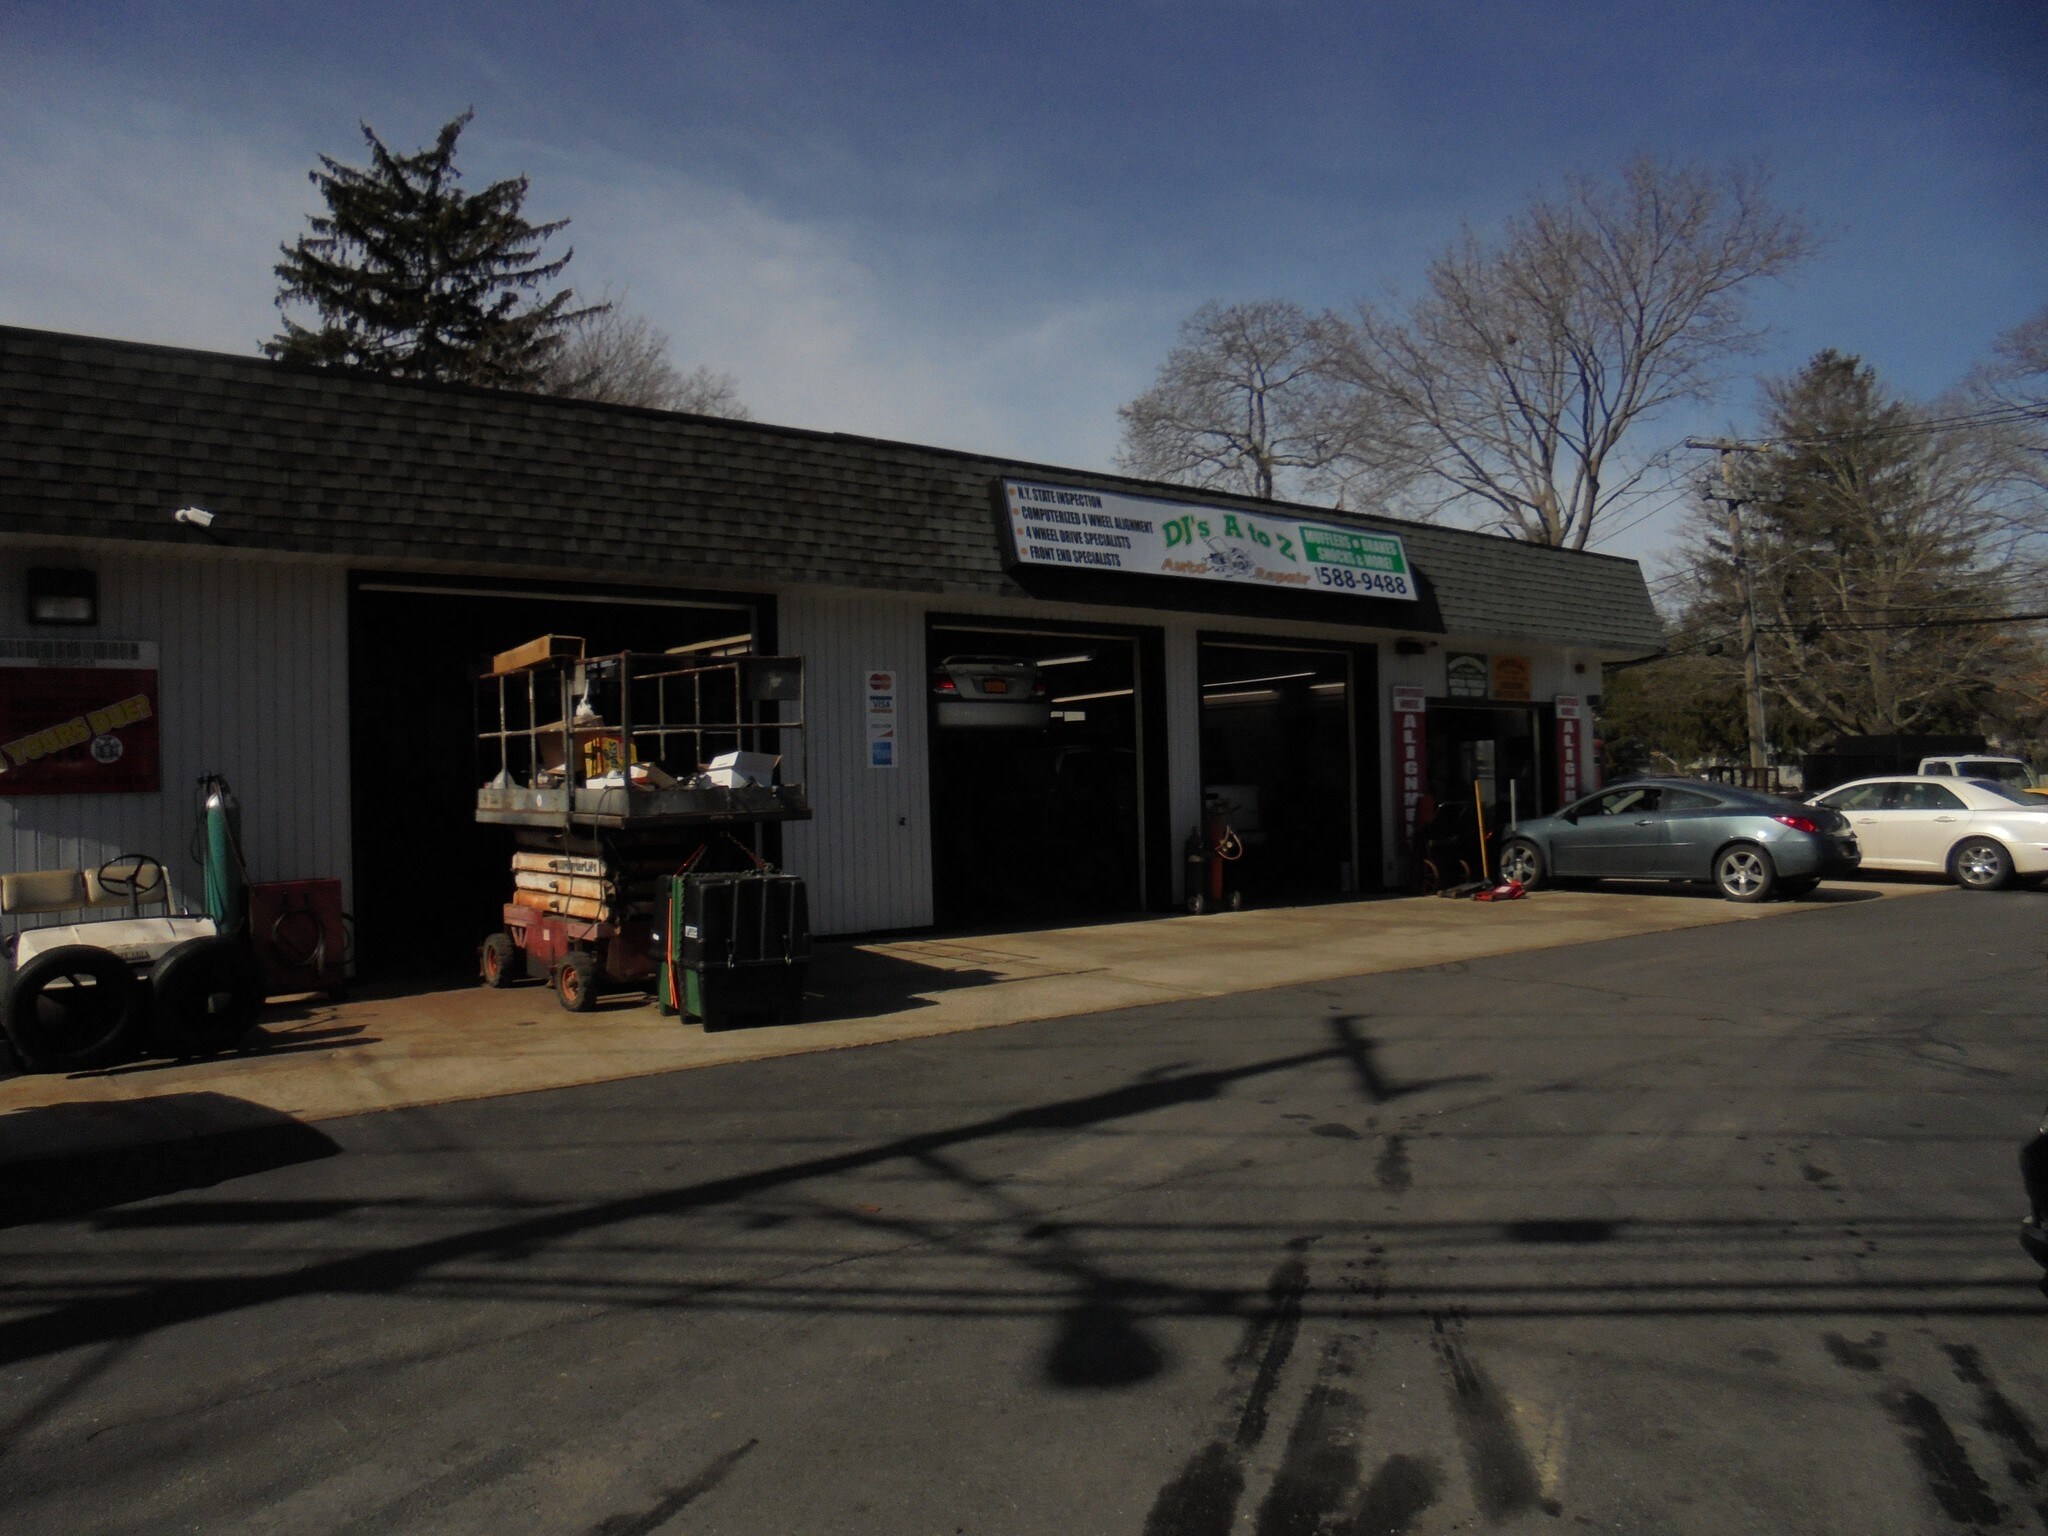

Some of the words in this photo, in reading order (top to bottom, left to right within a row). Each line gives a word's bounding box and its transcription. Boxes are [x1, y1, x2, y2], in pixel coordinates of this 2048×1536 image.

[1032, 488, 1056, 501] STATE
[1056, 491, 1103, 509] INSPECTION
[1021, 506, 1082, 525] COMPUTERIZED
[1081, 513, 1088, 526] 4
[1088, 514, 1114, 528] WHEEL
[1114, 517, 1154, 534] ALIGNMENT
[1162, 515, 1211, 548] DJ's
[1223, 514, 1244, 539] A
[1248, 522, 1272, 547] to
[1025, 526, 1032, 539] 4
[1032, 527, 1059, 542] WHEEL
[1060, 530, 1083, 544] DRIVE
[1083, 532, 1131, 549] SPECIALISTS
[1029, 546, 1055, 560] FRONT
[1056, 549, 1072, 562] END
[1073, 550, 1121, 567] SPECIALISTS
[873, 701, 891, 709] VISA
